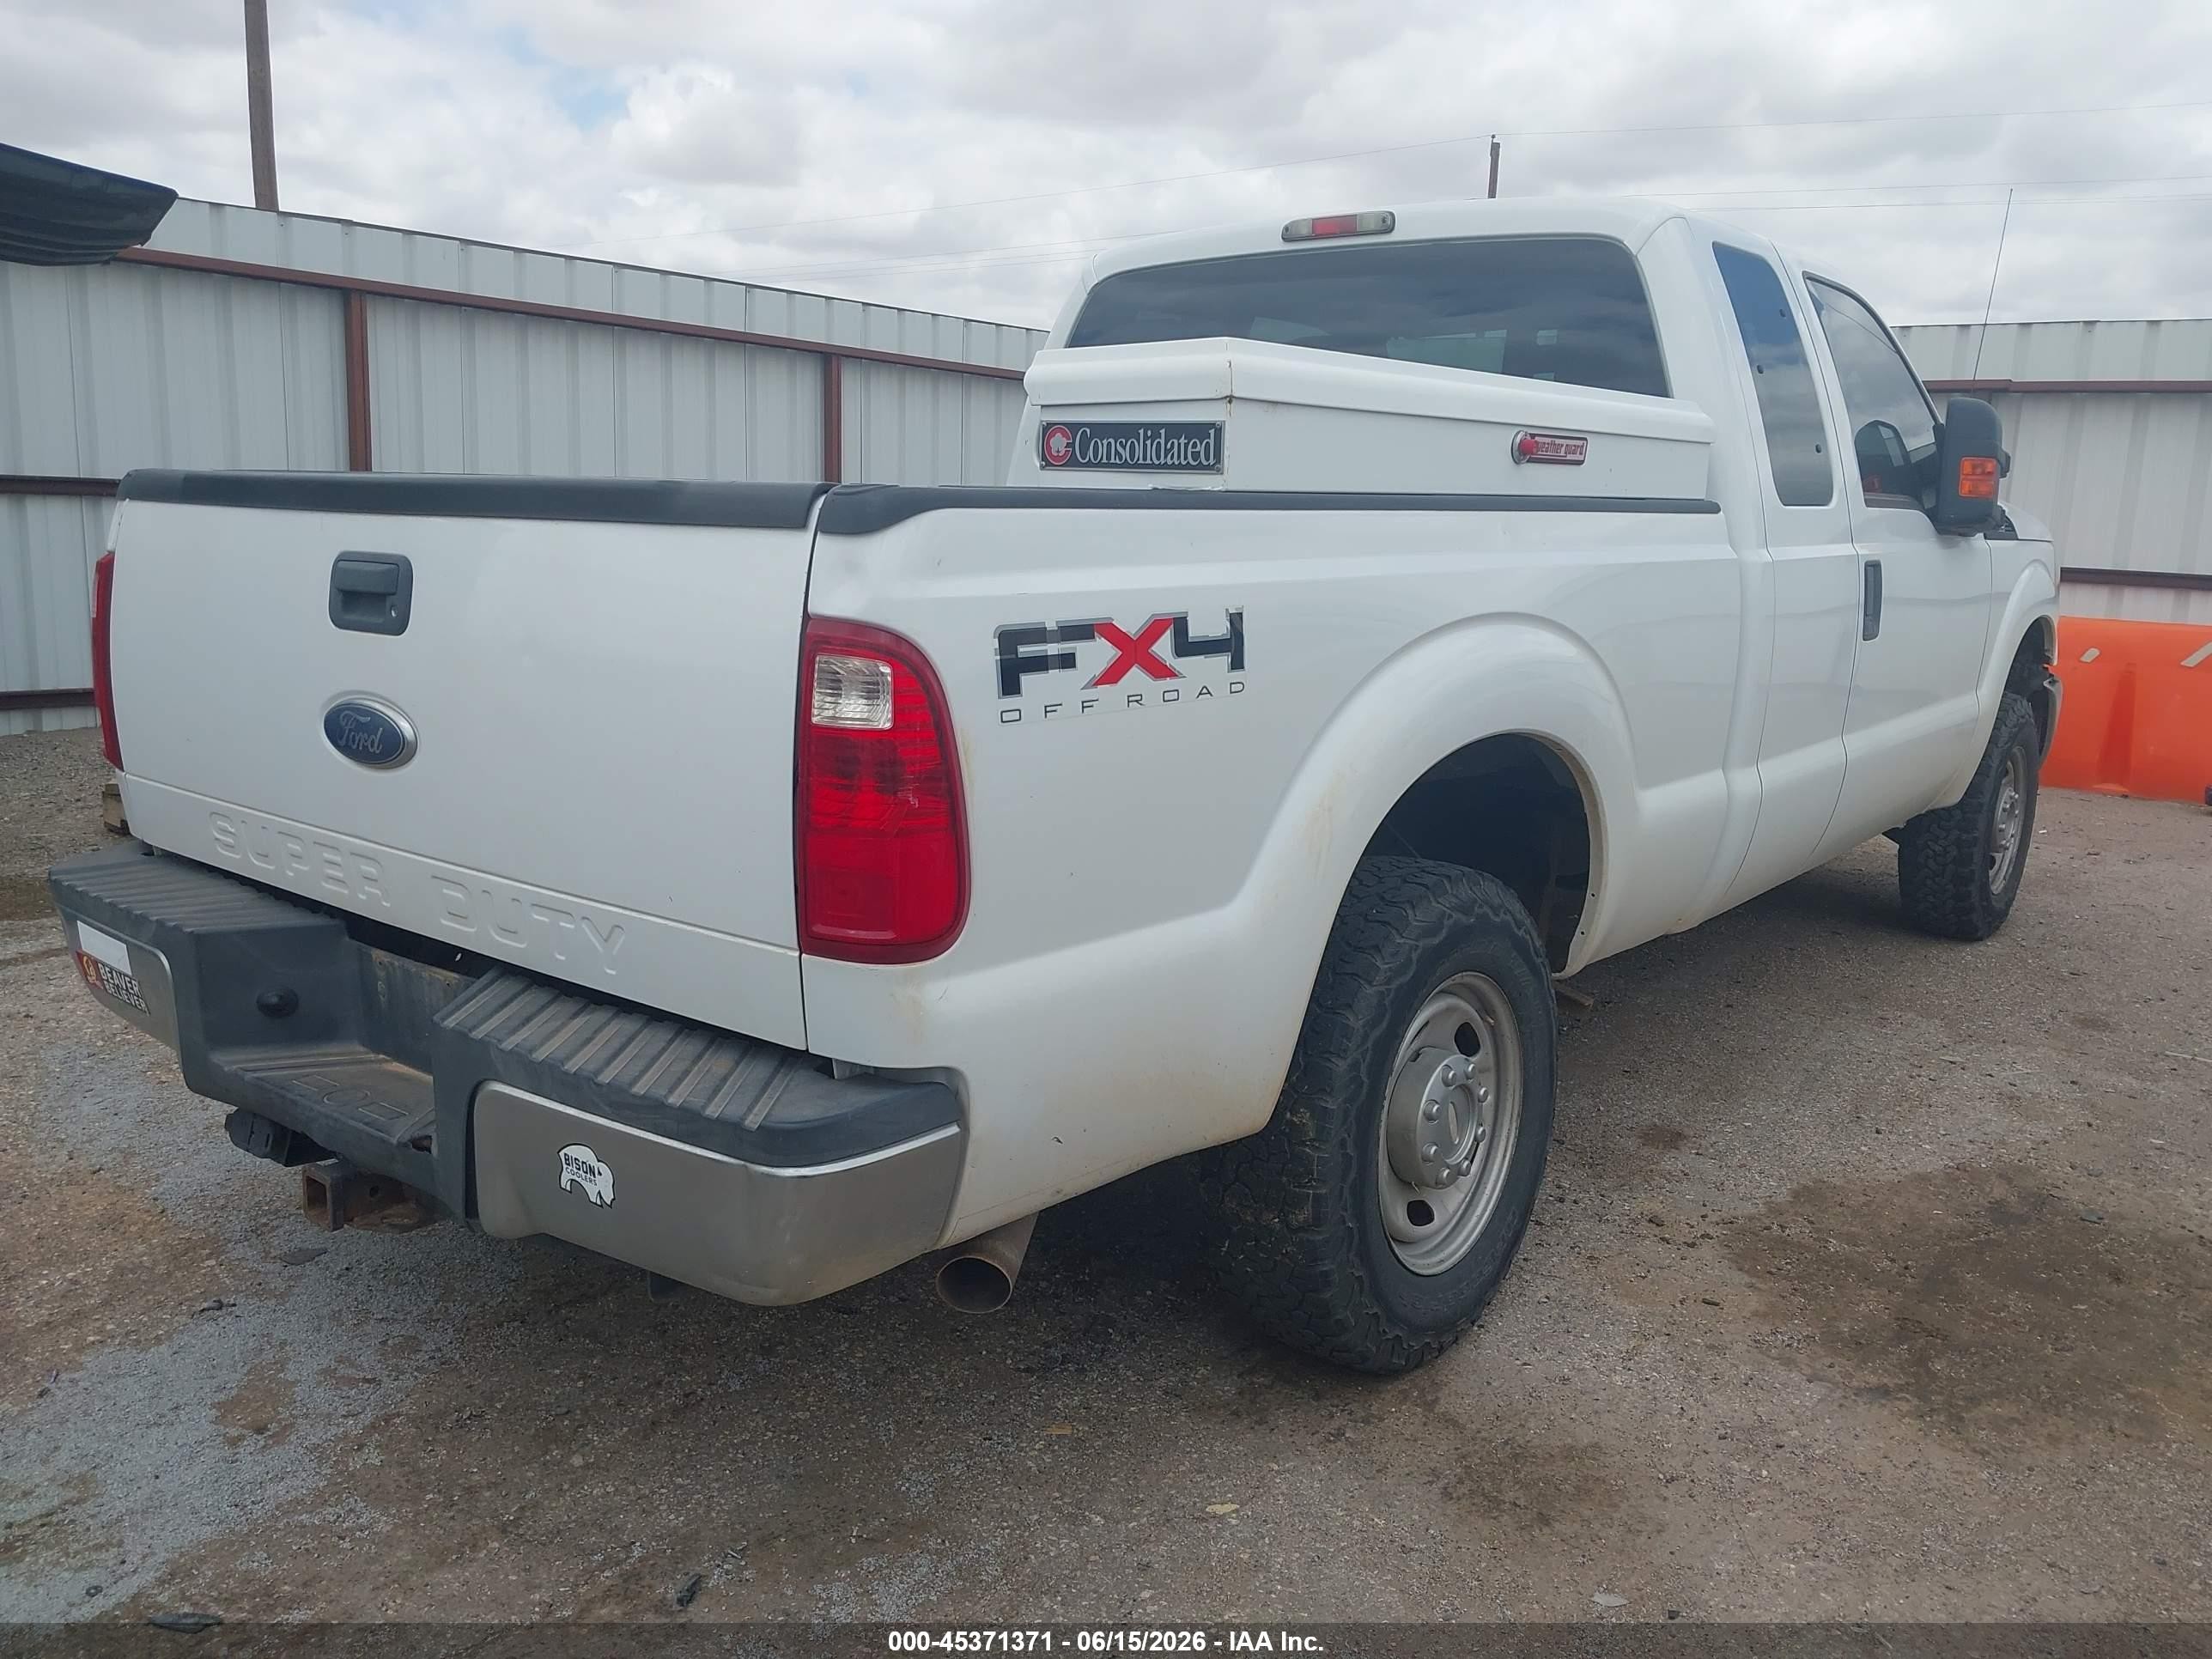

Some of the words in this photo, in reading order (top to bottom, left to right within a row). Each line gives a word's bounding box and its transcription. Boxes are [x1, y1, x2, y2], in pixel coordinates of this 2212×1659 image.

[1074, 427, 1217, 466] Consolidated
[1565, 441, 1585, 456] guard
[994, 605, 1245, 700] FX4
[1000, 698, 1099, 724] OFF
[1127, 681, 1245, 708] ROAD
[337, 710, 383, 754] Ford
[209, 811, 391, 908] SUPER
[431, 874, 626, 975] DUTY
[97, 963, 142, 998] BEAVER
[103, 981, 149, 1015] BELIEVER
[563, 1152, 597, 1179] BISON
[565, 1167, 598, 1187] COOLERS
